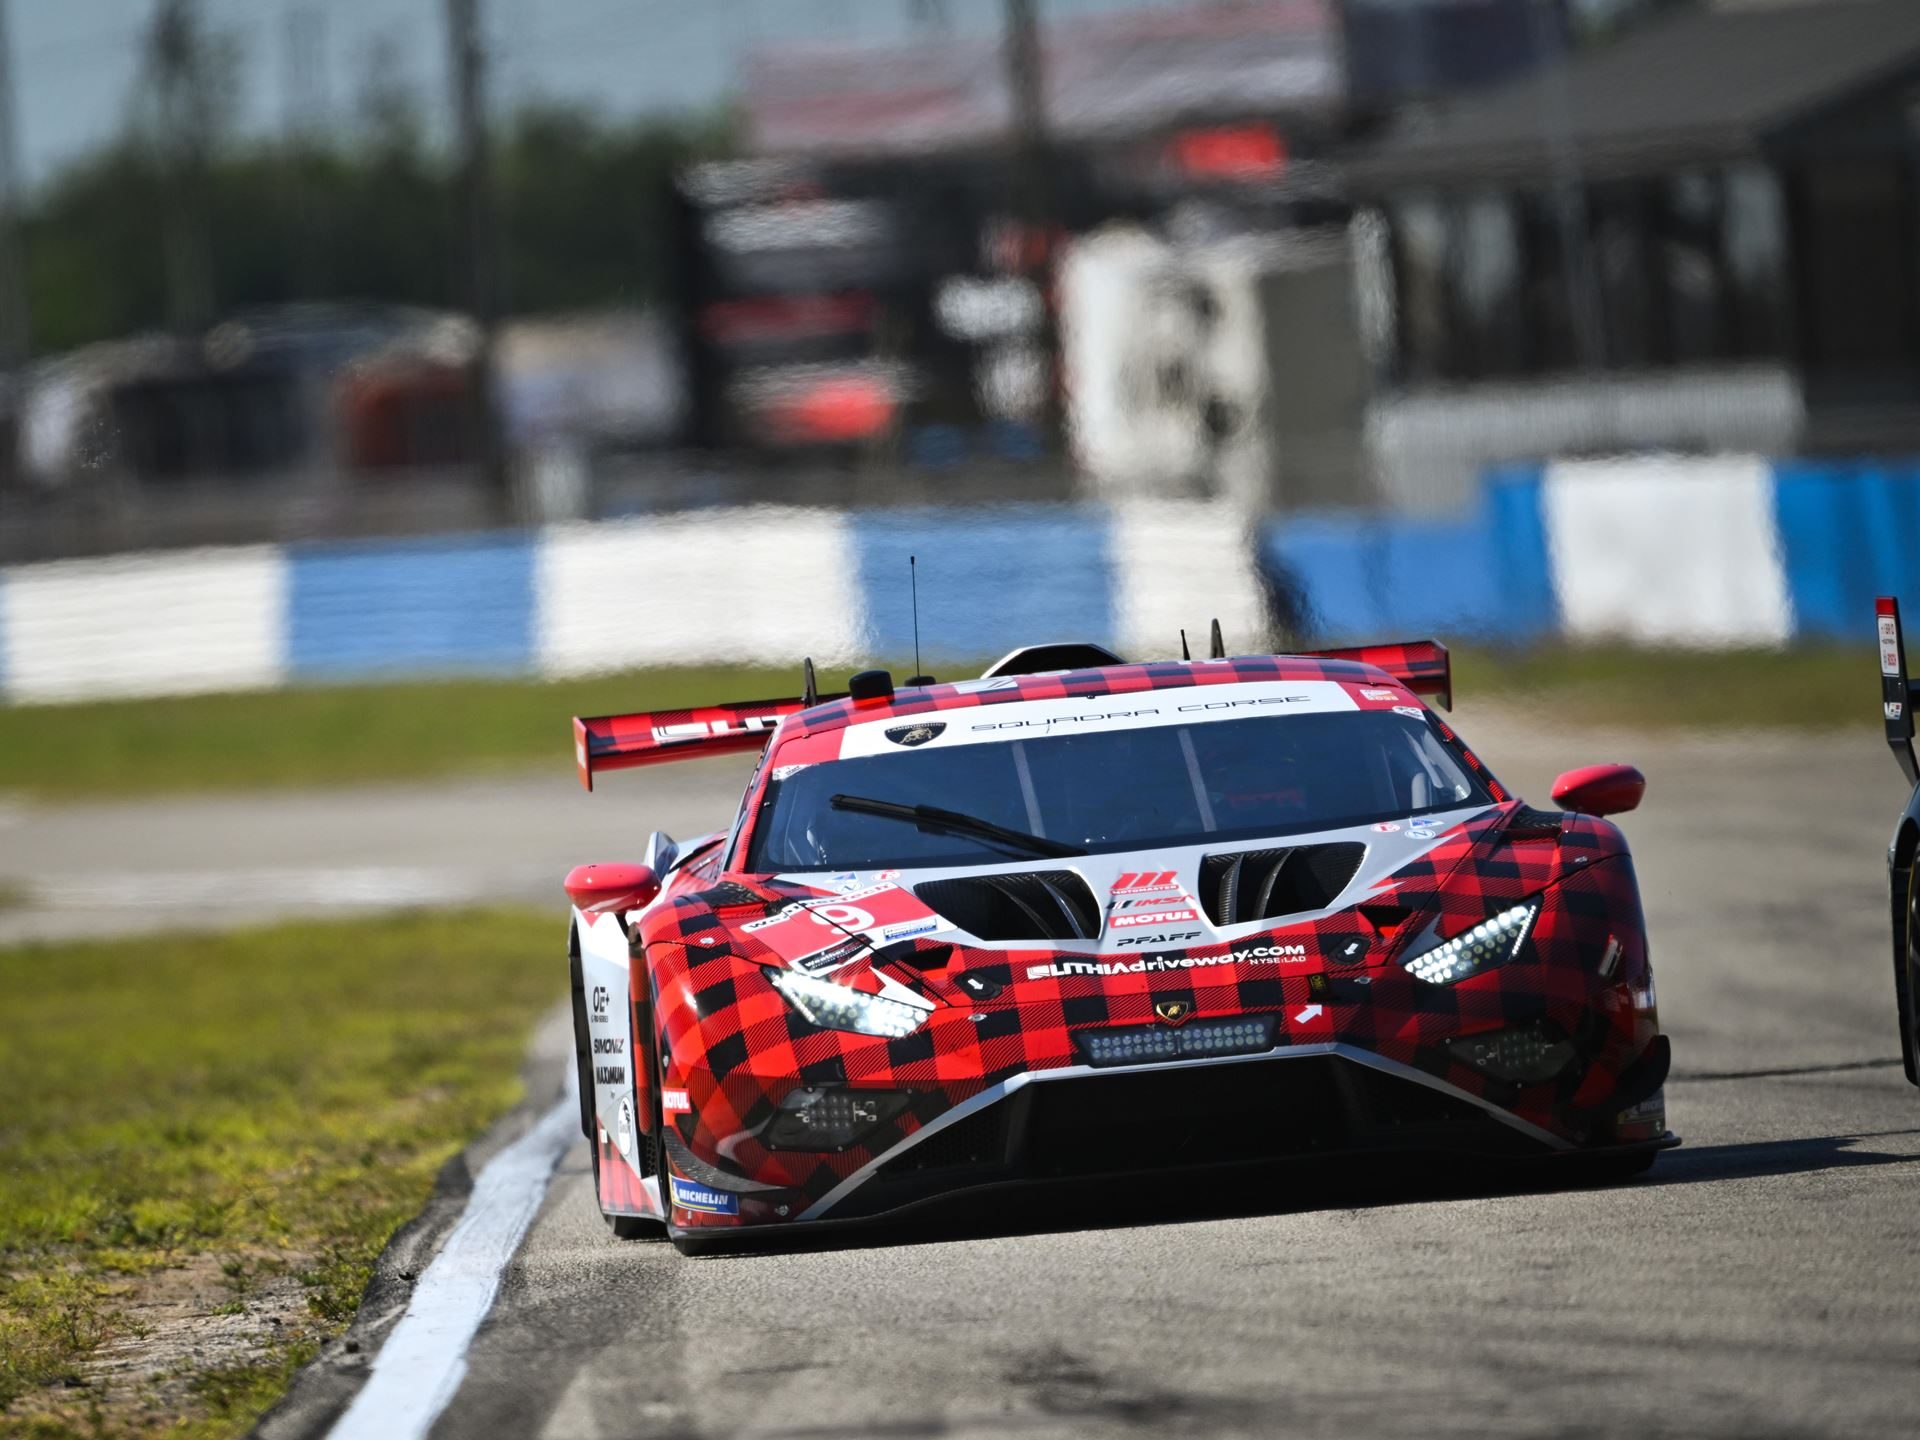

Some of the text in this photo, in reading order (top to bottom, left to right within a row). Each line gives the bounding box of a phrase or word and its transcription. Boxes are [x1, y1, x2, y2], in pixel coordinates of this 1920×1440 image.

[971, 695, 1311, 733] SQUADRA CORSE
[1112, 885, 1178, 895] MOTOMASTER
[1134, 895, 1194, 907] IMSA
[810, 904, 875, 934] 9
[1114, 910, 1194, 926] MOTUL
[1116, 931, 1202, 947] PFAFF
[593, 986, 610, 1012] OE+
[593, 1038, 624, 1054] SIMONIZ
[595, 1066, 625, 1084] MAXIMUM
[679, 1189, 729, 1205] MICHELIN
